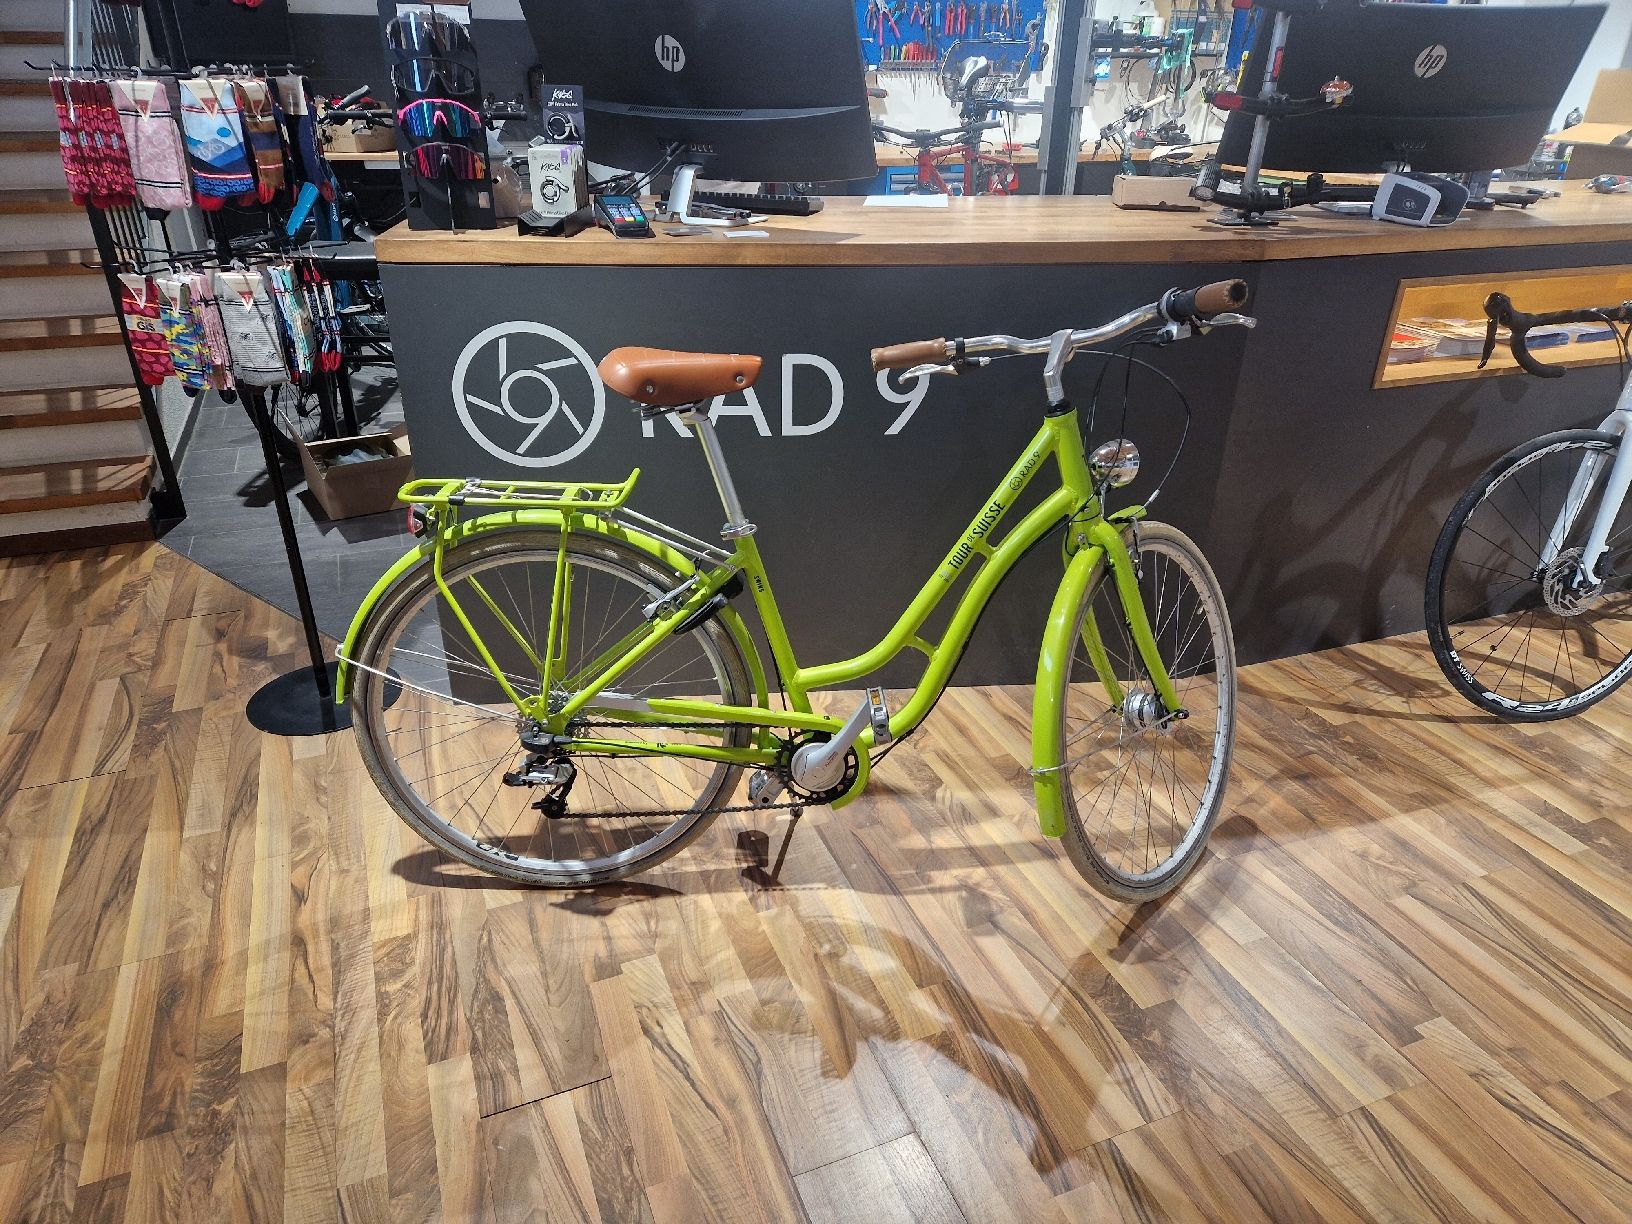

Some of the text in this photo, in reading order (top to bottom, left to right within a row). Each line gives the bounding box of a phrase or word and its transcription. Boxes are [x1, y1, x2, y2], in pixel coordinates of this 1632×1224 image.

[659, 35, 682, 73] hp
[1417, 44, 1446, 79] hp
[876, 367, 931, 436] 9
[1020, 451, 1041, 478] RAD 9
[948, 542, 974, 569] TOUR
[972, 500, 1006, 539] SUISSE
[1457, 662, 1475, 684] SWISS
